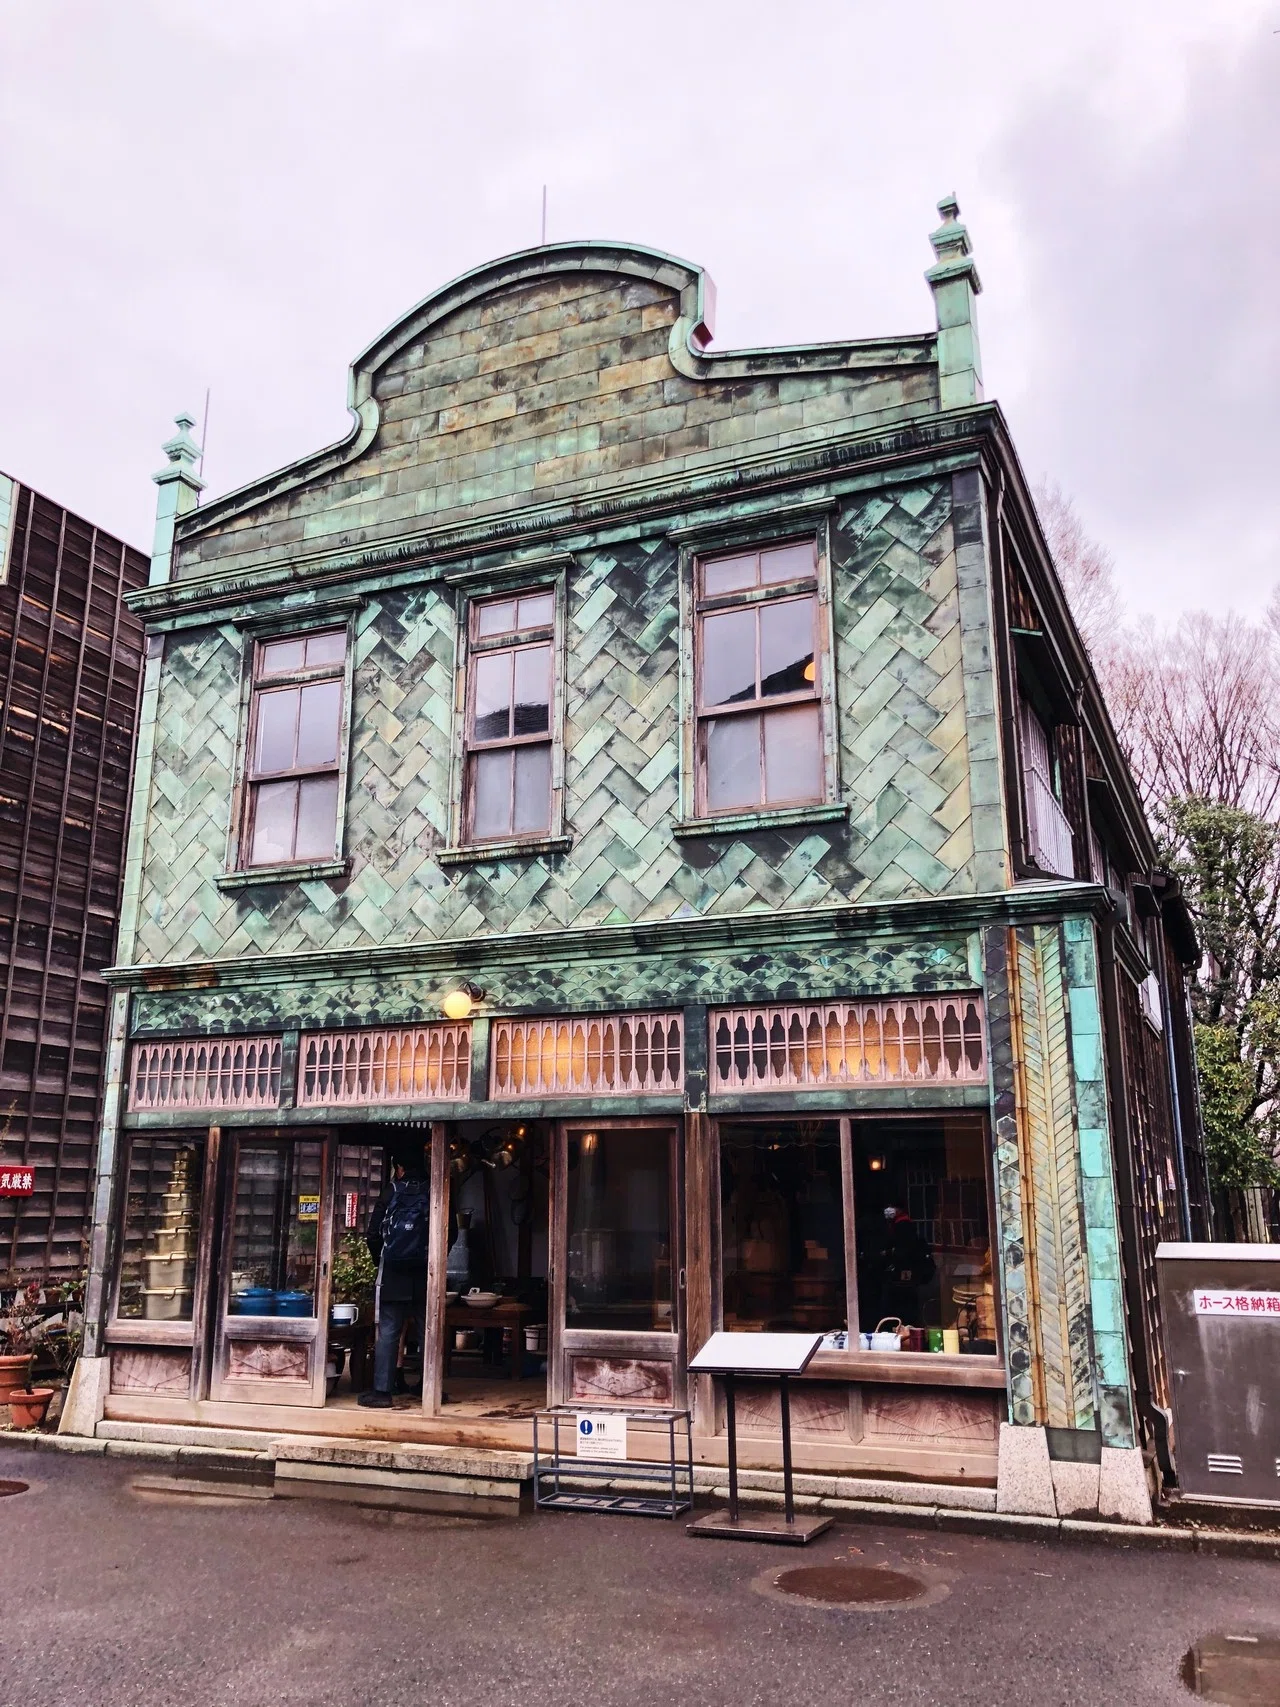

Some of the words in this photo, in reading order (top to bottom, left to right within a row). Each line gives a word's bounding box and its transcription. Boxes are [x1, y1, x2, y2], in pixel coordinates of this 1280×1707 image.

[1199, 1295, 1280, 1312] ホース格納箱
